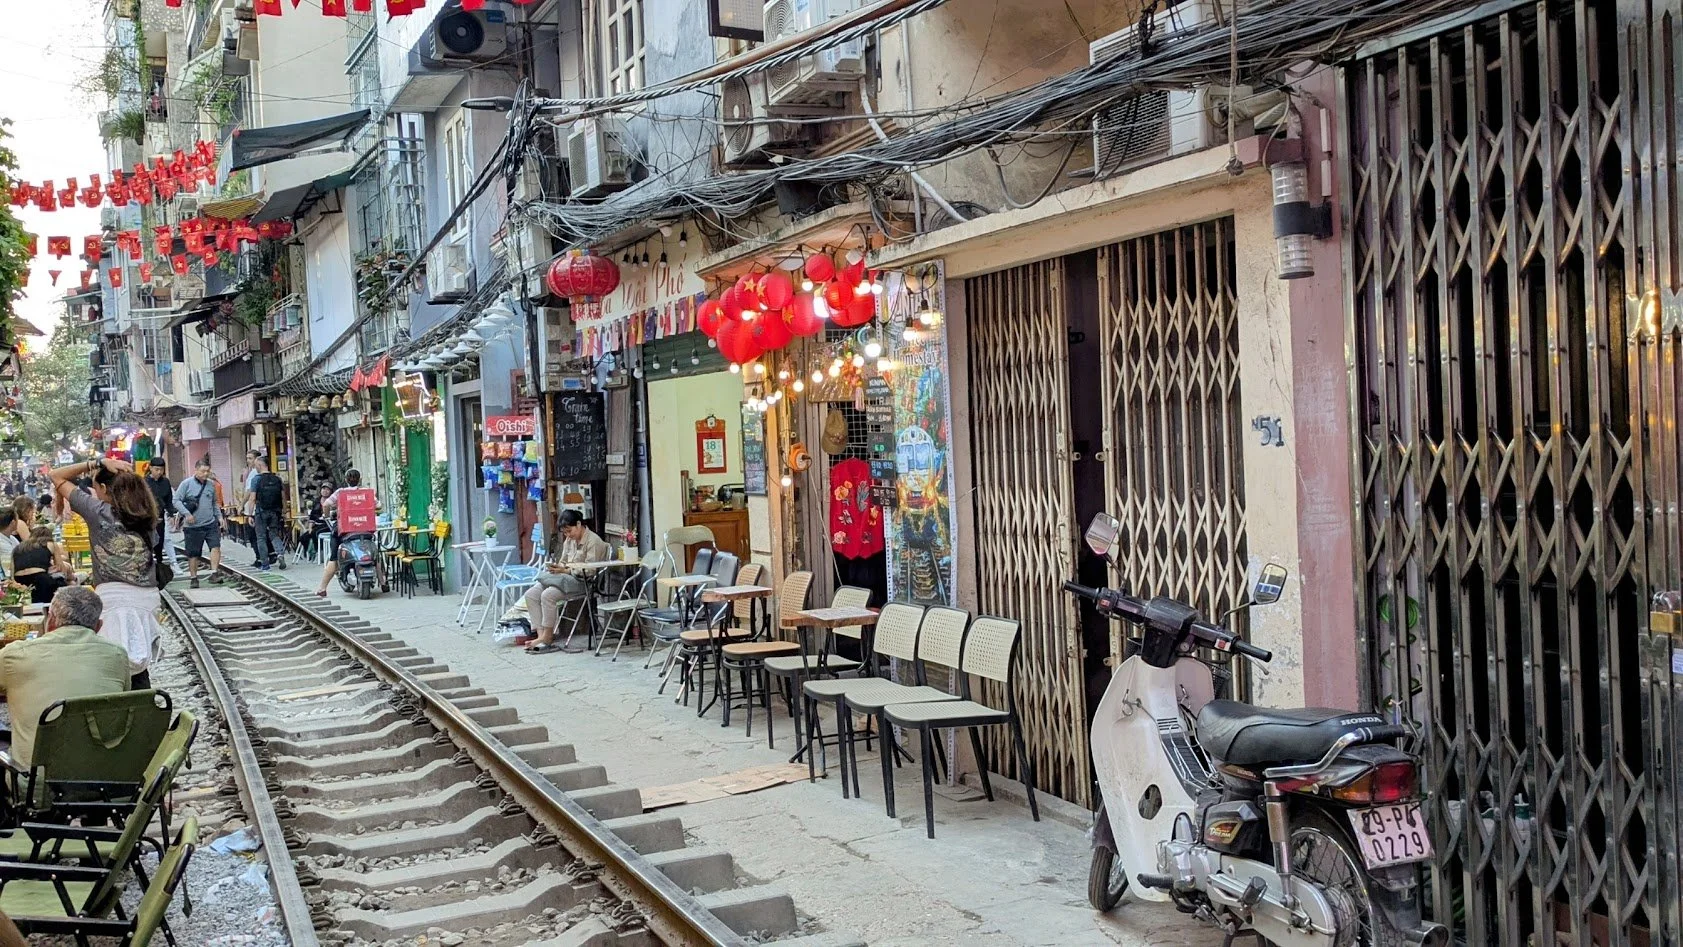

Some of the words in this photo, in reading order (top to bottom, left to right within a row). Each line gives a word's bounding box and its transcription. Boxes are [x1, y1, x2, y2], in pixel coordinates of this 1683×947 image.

[561, 396, 590, 413] Train
[573, 412, 593, 424] time
[496, 418, 528, 433] Oishi
[705, 441, 717, 450] 18
[1340, 716, 1383, 727] HONDA
[1371, 831, 1425, 862] 0229
